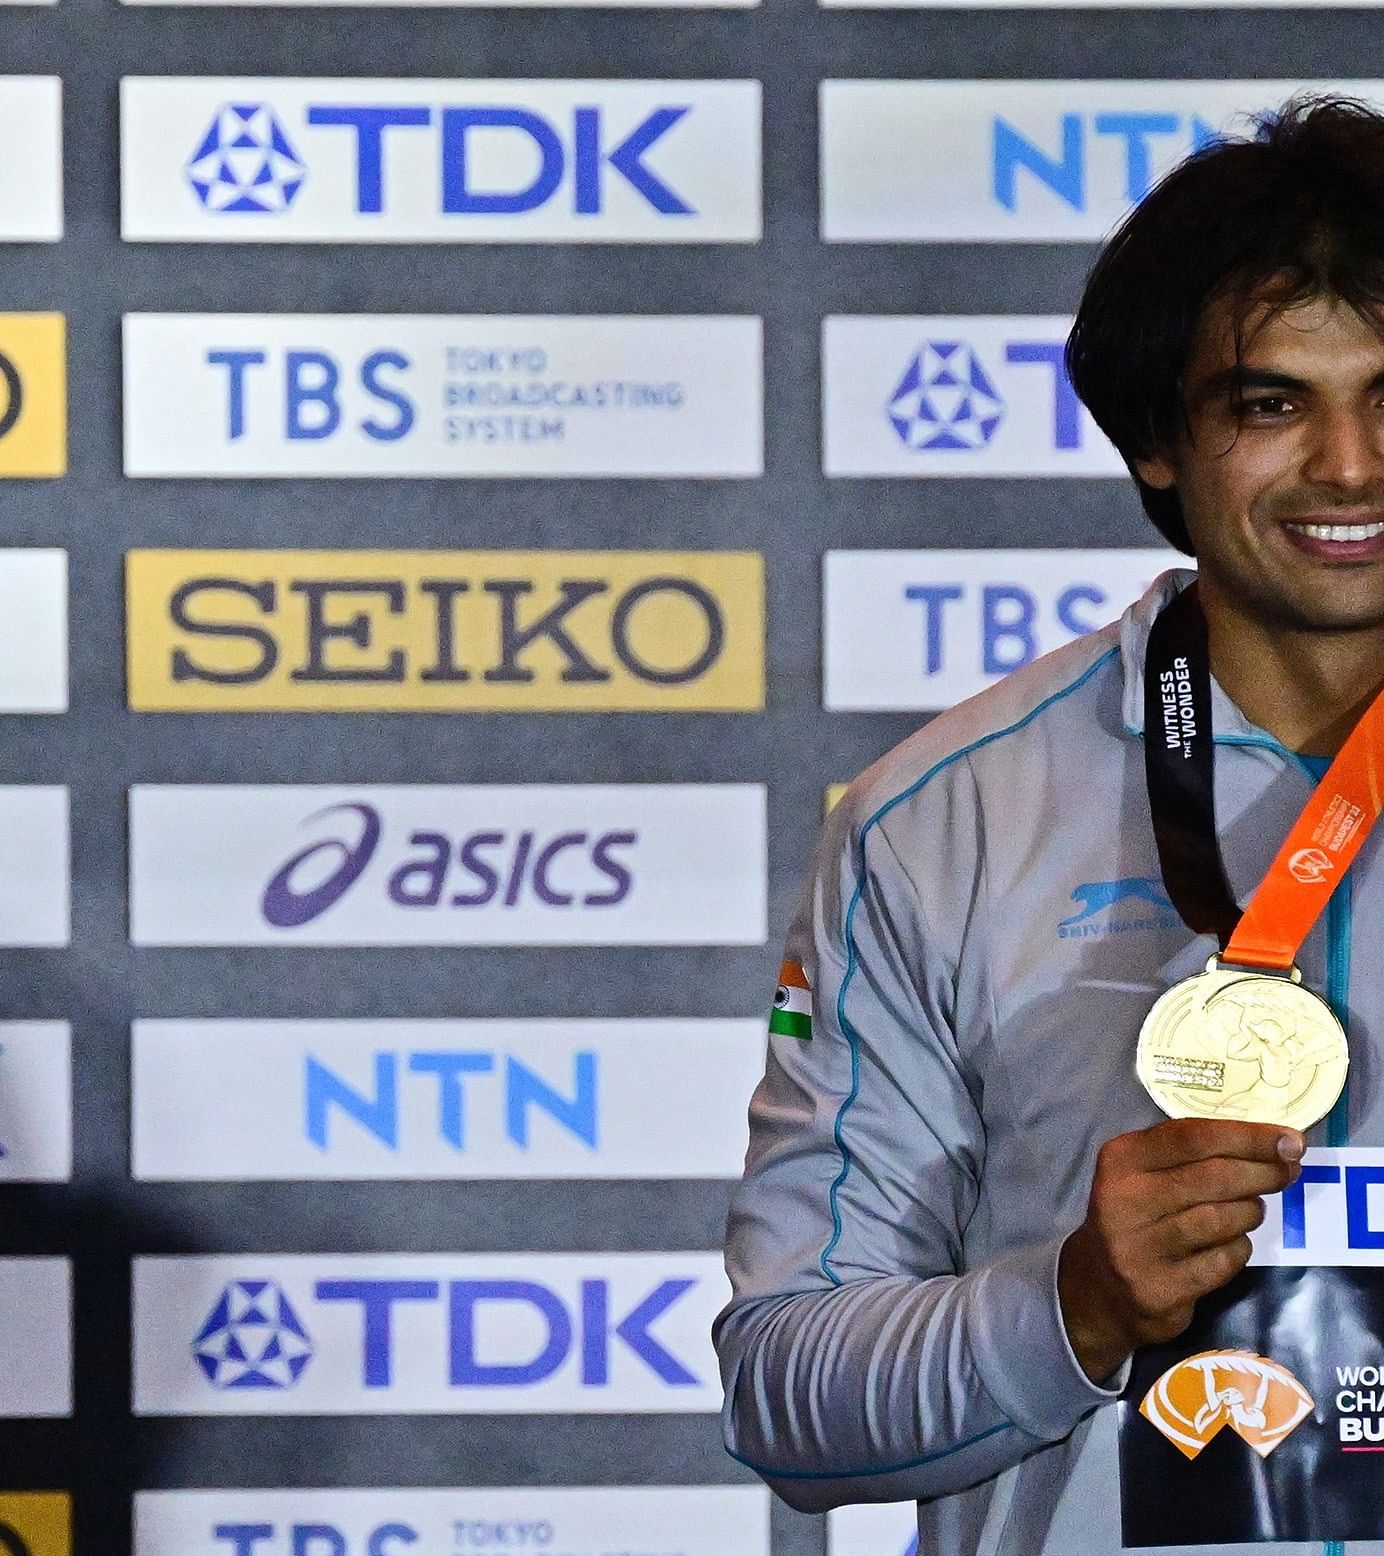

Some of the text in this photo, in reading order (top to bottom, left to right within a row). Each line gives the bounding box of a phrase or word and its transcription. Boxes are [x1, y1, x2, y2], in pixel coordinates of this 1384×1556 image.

[307, 104, 697, 216] TDK
[991, 112, 1226, 213] NT
[207, 349, 417, 443] TBS
[443, 347, 549, 375] TOKYO
[443, 381, 686, 410] BROADCASTING
[443, 416, 566, 443] SYSTEM
[168, 577, 725, 686] SEIKO
[1160, 670, 1181, 749] WITNESS
[1174, 657, 1197, 760] THE WONDER
[386, 828, 639, 908] asics
[304, 1051, 599, 1151] NTN
[315, 1279, 700, 1388] TDK
